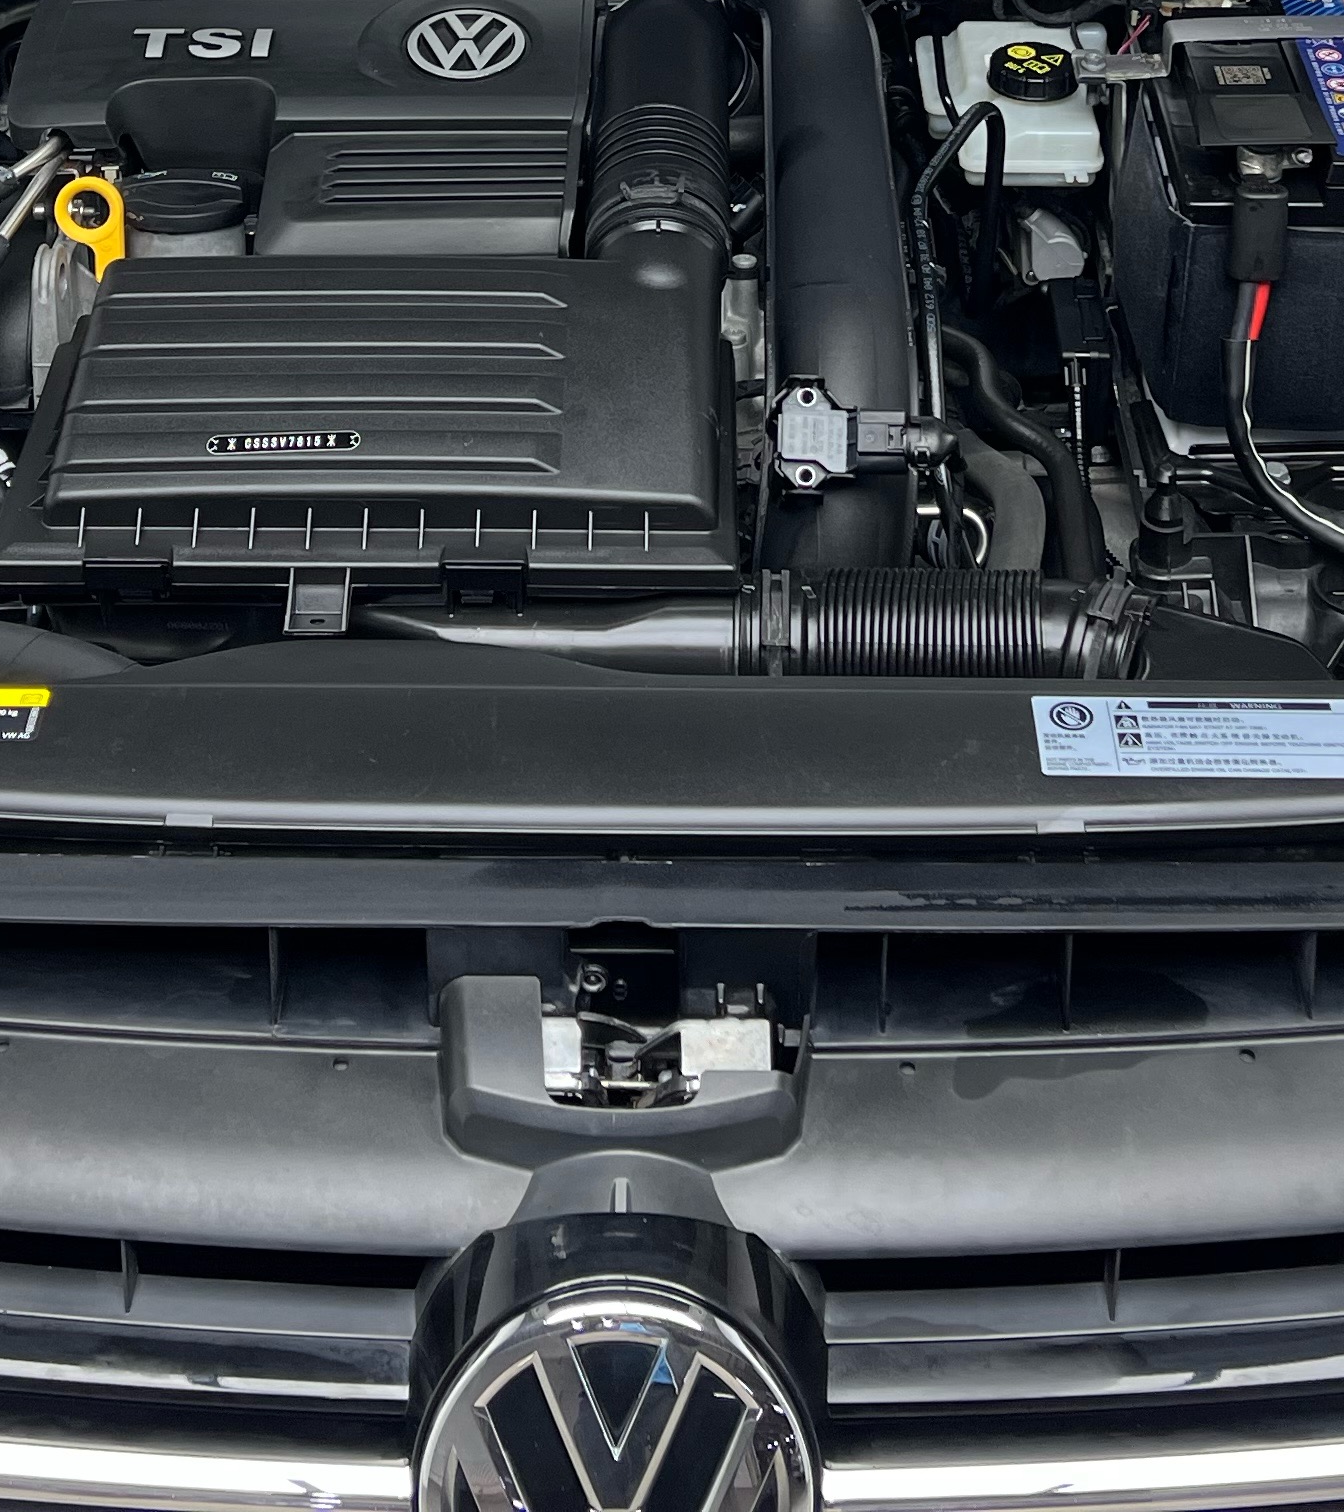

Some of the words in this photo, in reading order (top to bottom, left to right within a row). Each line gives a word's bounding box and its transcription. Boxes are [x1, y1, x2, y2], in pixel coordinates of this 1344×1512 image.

[133, 27, 274, 59] TSI
[407, 8, 525, 79] VW
[1229, 702, 1283, 710] WARNING
